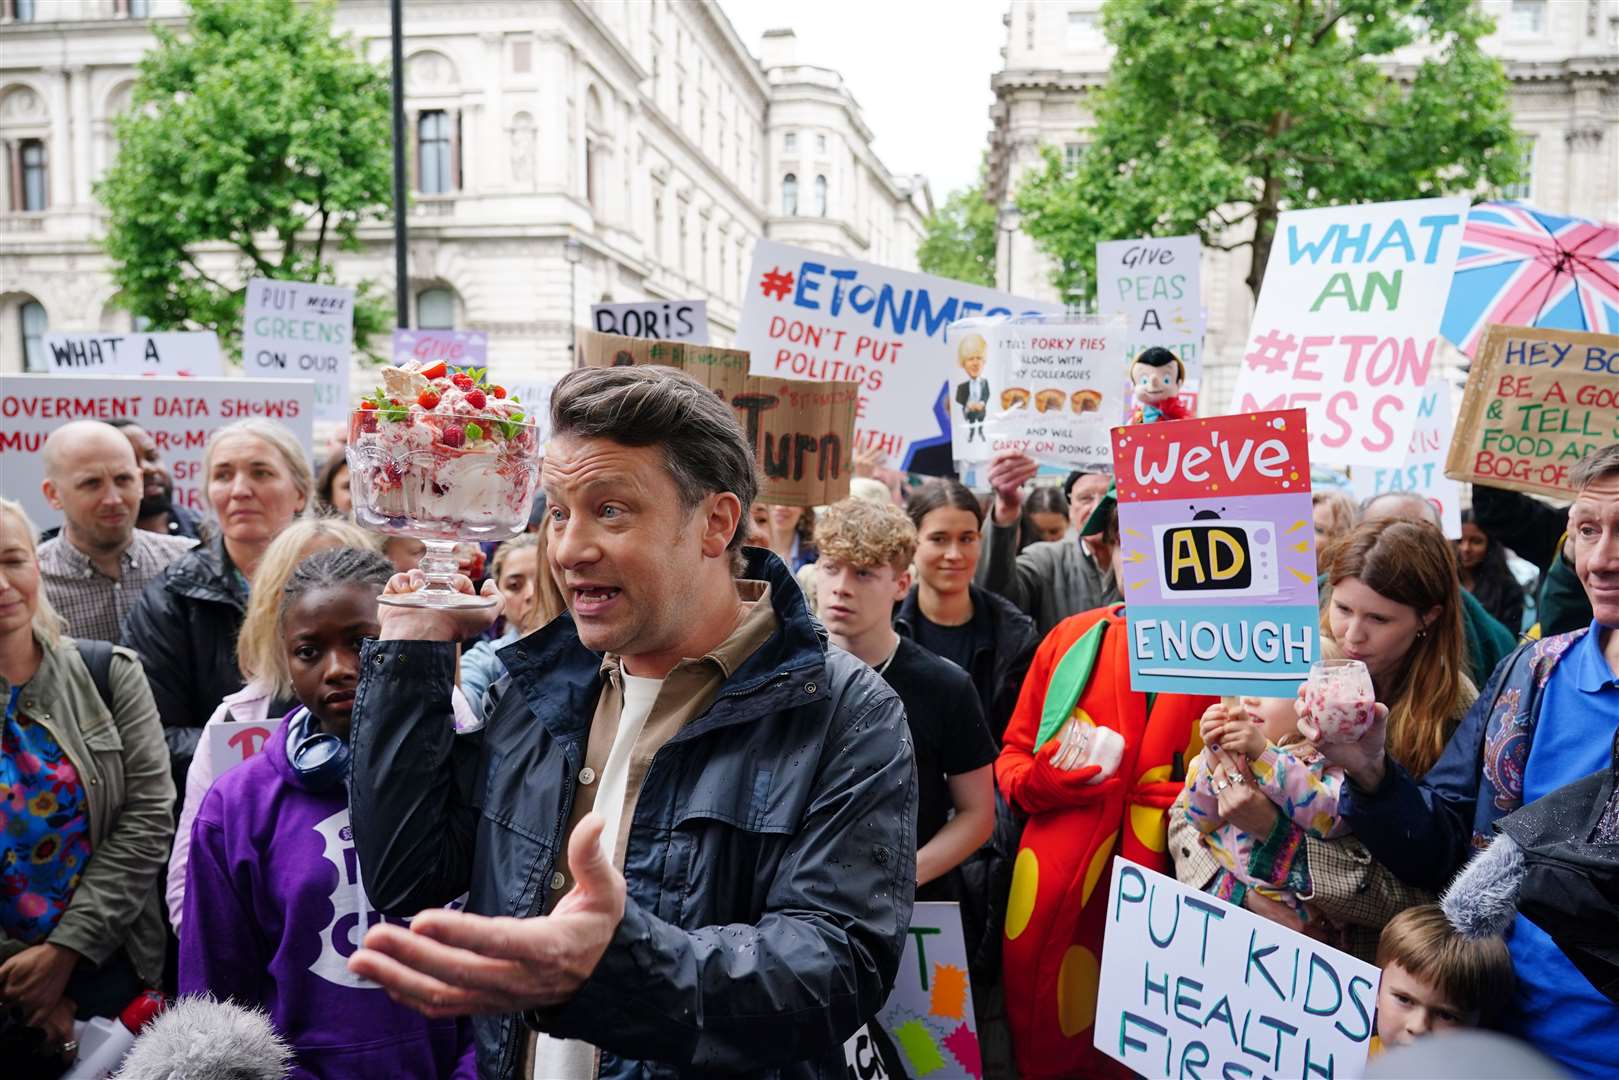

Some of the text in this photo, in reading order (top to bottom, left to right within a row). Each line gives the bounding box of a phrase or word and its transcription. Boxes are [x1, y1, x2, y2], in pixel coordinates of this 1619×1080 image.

[1287, 214, 1460, 265] WHAT
[261, 287, 297, 311] PUT
[1117, 274, 1186, 301] PEAS
[1309, 269, 1404, 312] AN
[253, 316, 346, 344] GREENS
[1140, 308, 1162, 331] A
[50, 337, 161, 367] WHAT A
[768, 315, 904, 365] DON'T PUT
[1031, 338, 1075, 350] PORKY
[1080, 338, 1106, 350] PIES
[1505, 340, 1572, 368] HEY
[256, 350, 338, 374] ON OUR
[775, 349, 883, 391] POLITICS
[1022, 355, 1083, 365] ALONG WITH
[1245, 329, 1437, 387] #ETON
[1031, 369, 1092, 380] COLLEAGUES
[1496, 374, 1534, 399] BE
[1542, 381, 1568, 403] A
[153, 398, 210, 419] DATA
[219, 398, 300, 419] SHOWS
[1486, 400, 1503, 420] &
[1518, 403, 1602, 436] TELL
[147, 430, 205, 450] ROM
[1026, 427, 1073, 438] AND WILL
[1481, 428, 1554, 457] FOOD
[992, 439, 1109, 456] CARRY ON DOING SO
[1375, 462, 1435, 496] FAST
[1170, 528, 1245, 585] AD
[1134, 618, 1313, 664] ENOUGH
[1116, 865, 1373, 1043] PUT KIDS
[1144, 960, 1334, 1080] HEALTH
[1119, 1010, 1273, 1080] FIR
